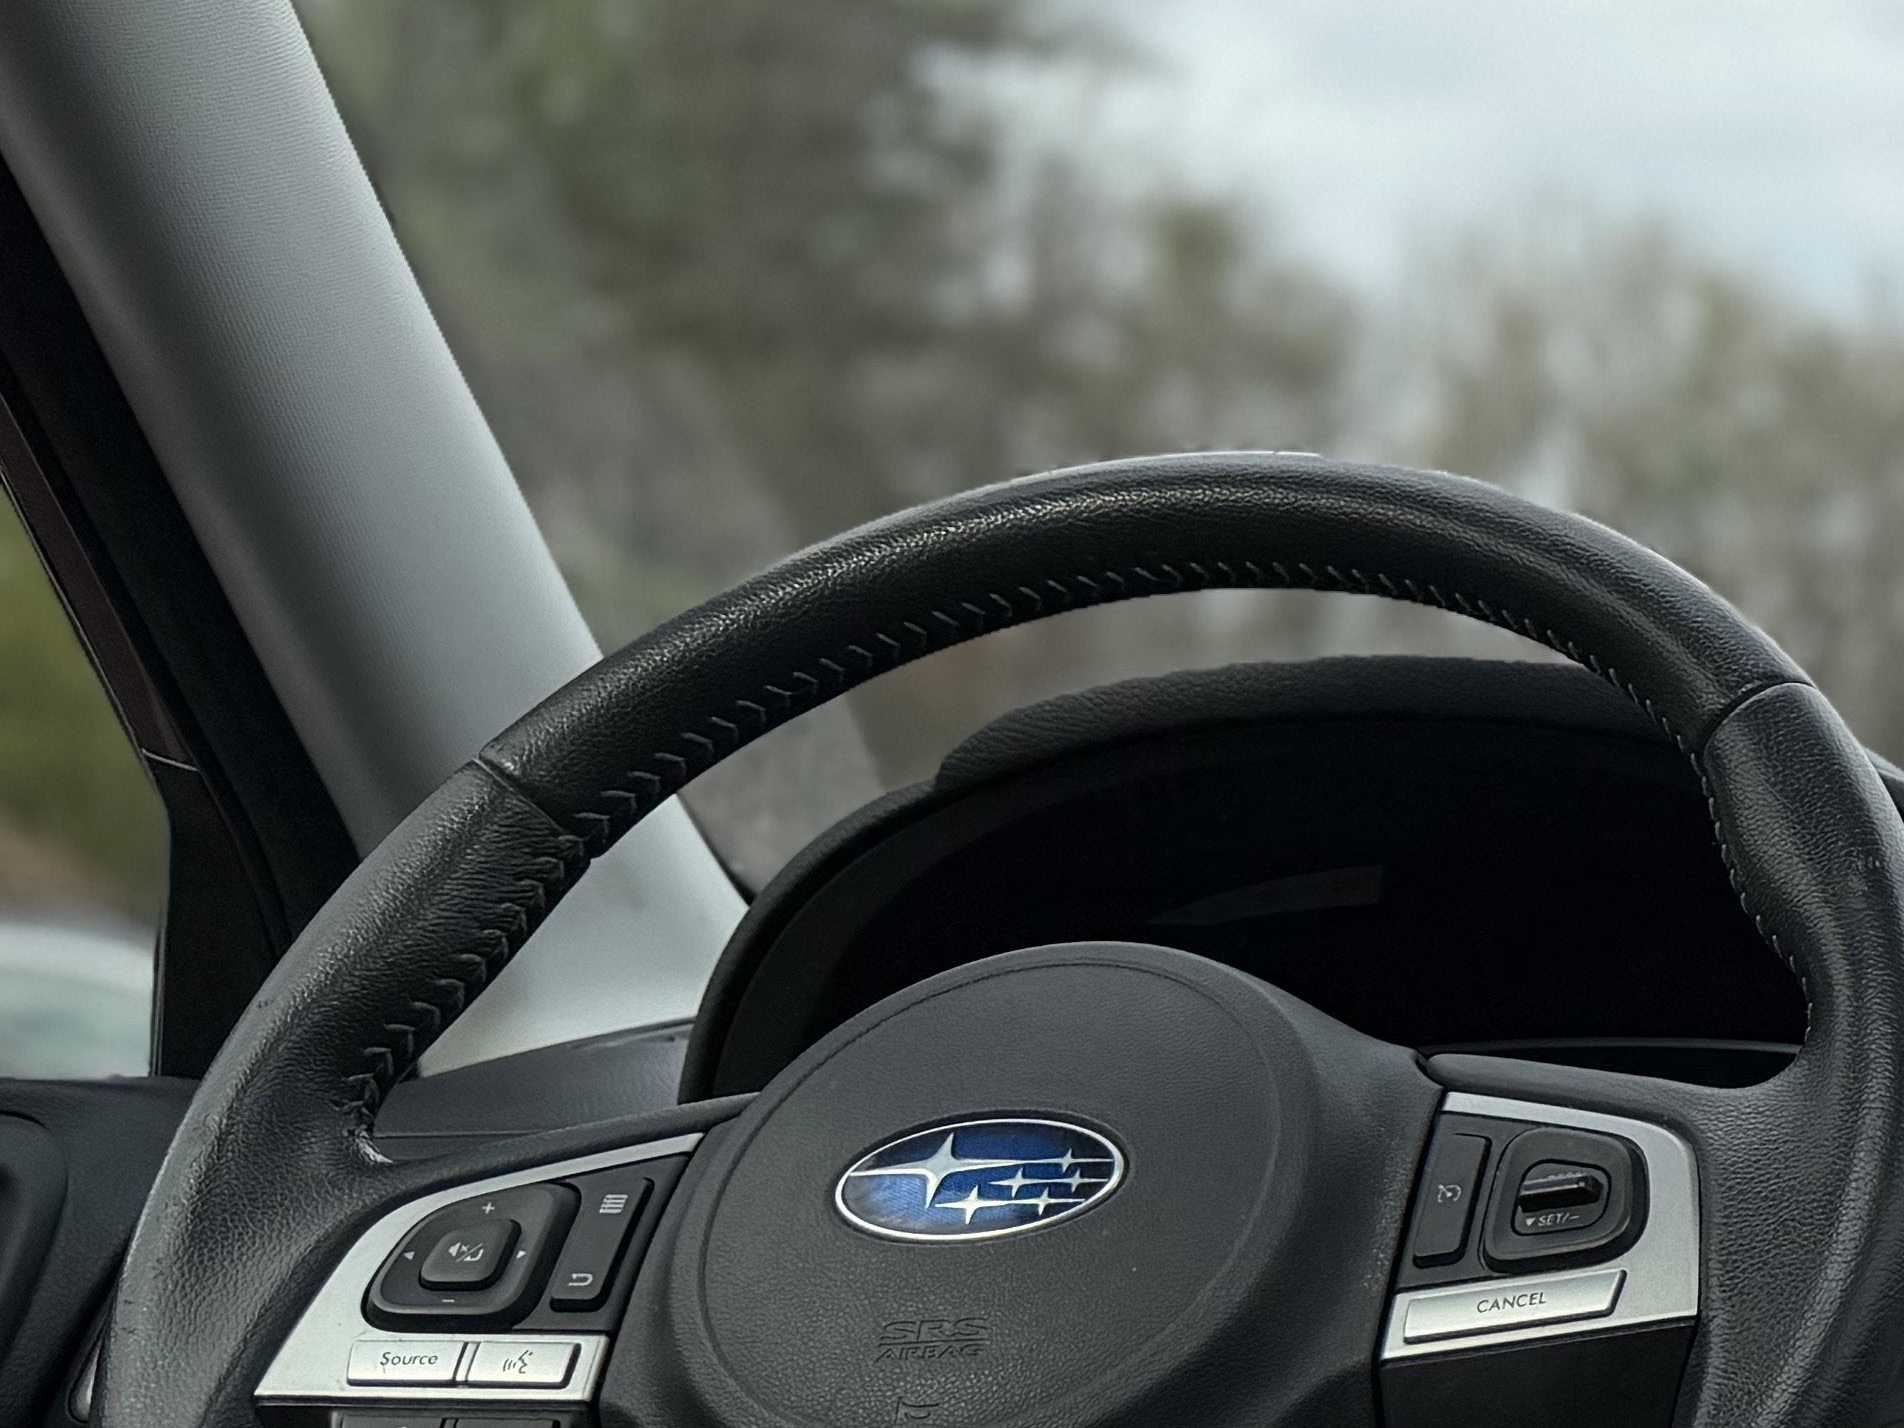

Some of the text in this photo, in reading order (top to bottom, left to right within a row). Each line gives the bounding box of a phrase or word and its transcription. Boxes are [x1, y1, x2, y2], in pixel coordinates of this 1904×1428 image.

[1476, 1291, 1547, 1314] CANCEL
[882, 1316, 990, 1341] SRS
[378, 1350, 439, 1369] Source
[873, 1343, 991, 1361] AIRBAG
